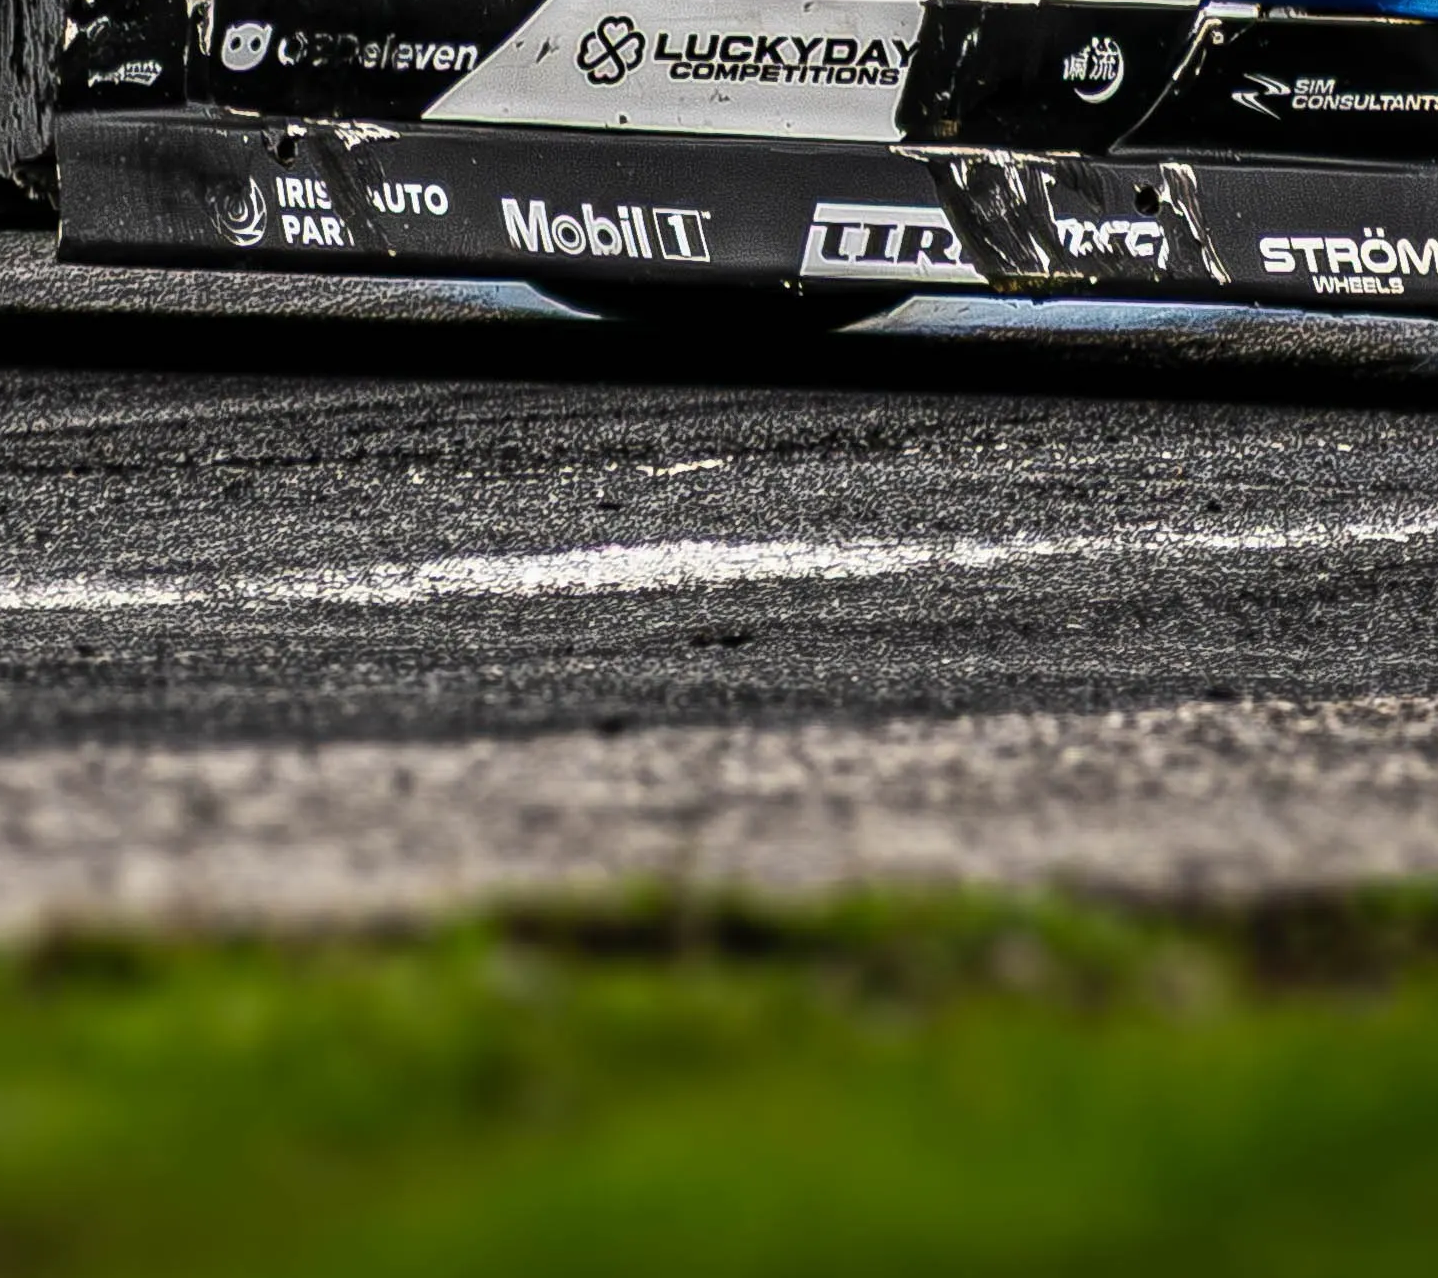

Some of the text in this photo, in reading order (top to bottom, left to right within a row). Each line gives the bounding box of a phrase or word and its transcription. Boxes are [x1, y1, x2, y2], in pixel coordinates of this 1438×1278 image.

[654, 33, 920, 68] LUCKYDAY
[669, 62, 901, 86] COMPETITIONS
[1293, 79, 1336, 94] SIM
[276, 176, 333, 210] IRIS
[281, 214, 356, 247] PAR
[501, 198, 653, 259] Mobil
[1313, 275, 1405, 295] WHEELS
